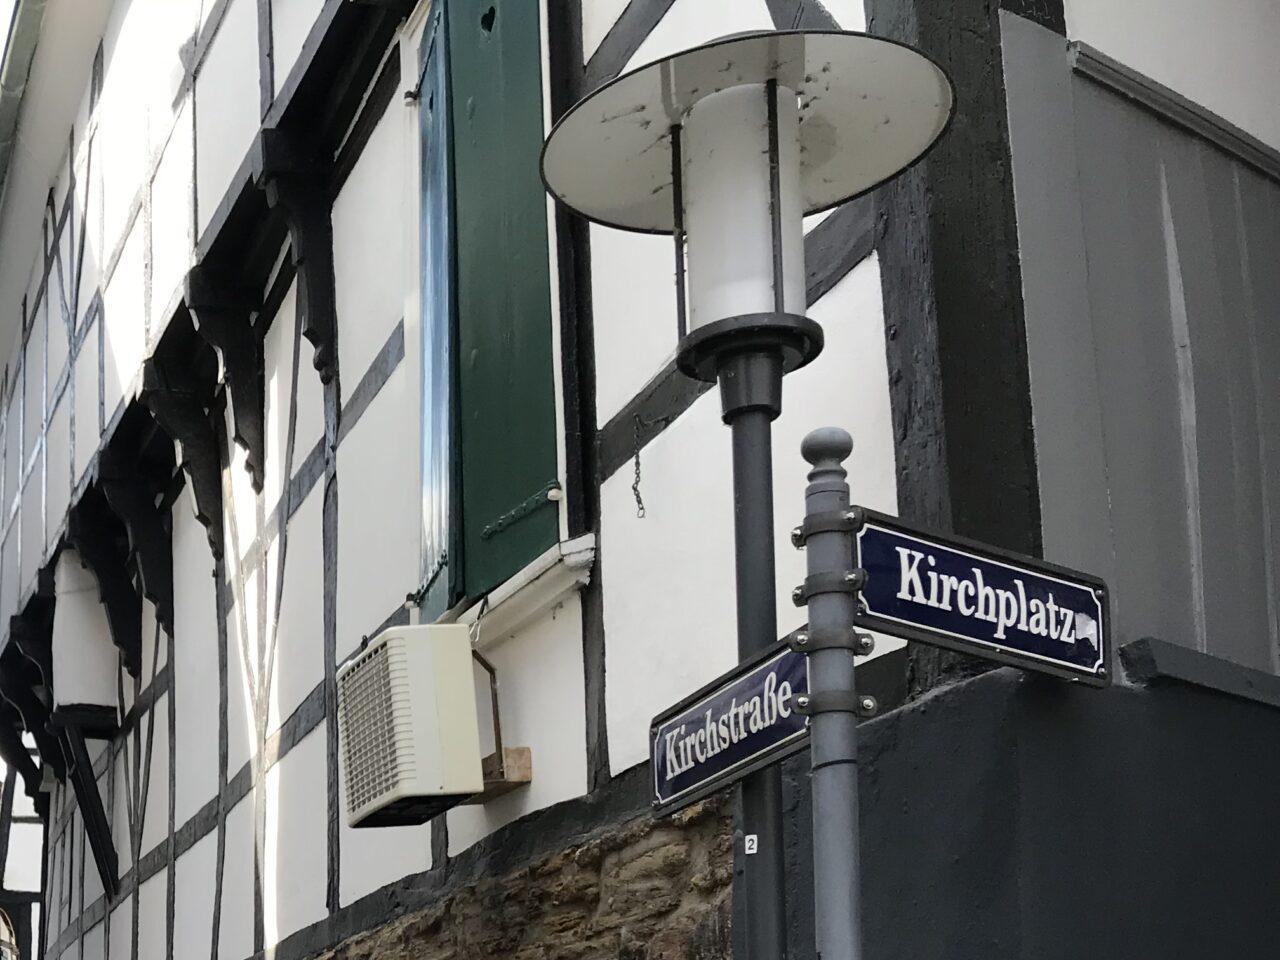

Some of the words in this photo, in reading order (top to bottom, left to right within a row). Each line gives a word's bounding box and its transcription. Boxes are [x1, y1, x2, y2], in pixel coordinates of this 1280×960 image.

[895, 546, 1077, 644] Kirchplatz
[664, 671, 792, 782] Kirchstraße
[747, 838, 755, 850] 2
